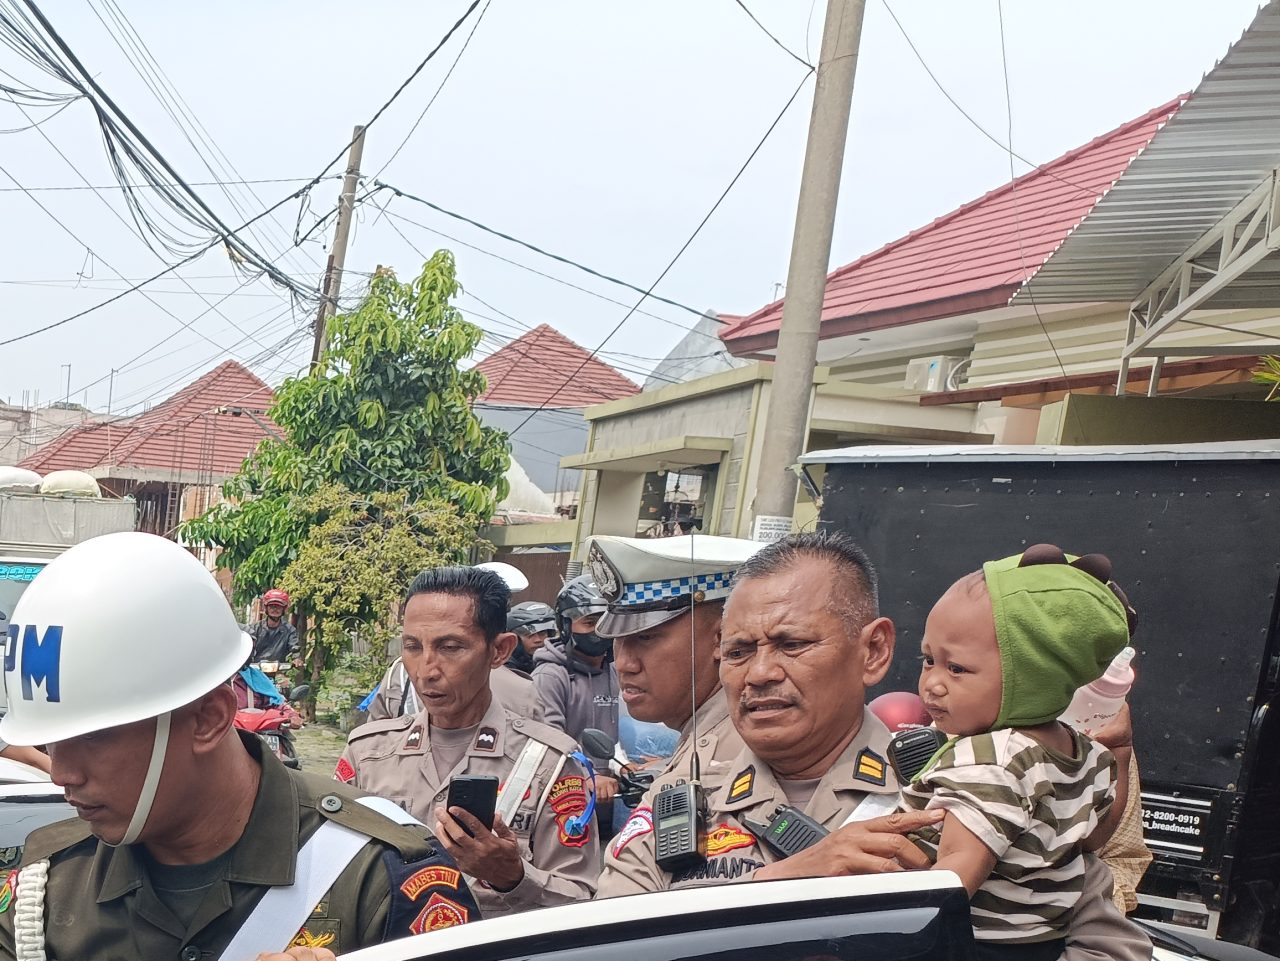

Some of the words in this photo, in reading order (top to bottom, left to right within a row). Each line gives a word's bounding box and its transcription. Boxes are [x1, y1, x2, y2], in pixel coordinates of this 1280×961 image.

[551, 778, 582, 792] OLRES
[406, 870, 437, 896] MABES
[440, 870, 456, 885] TNI
